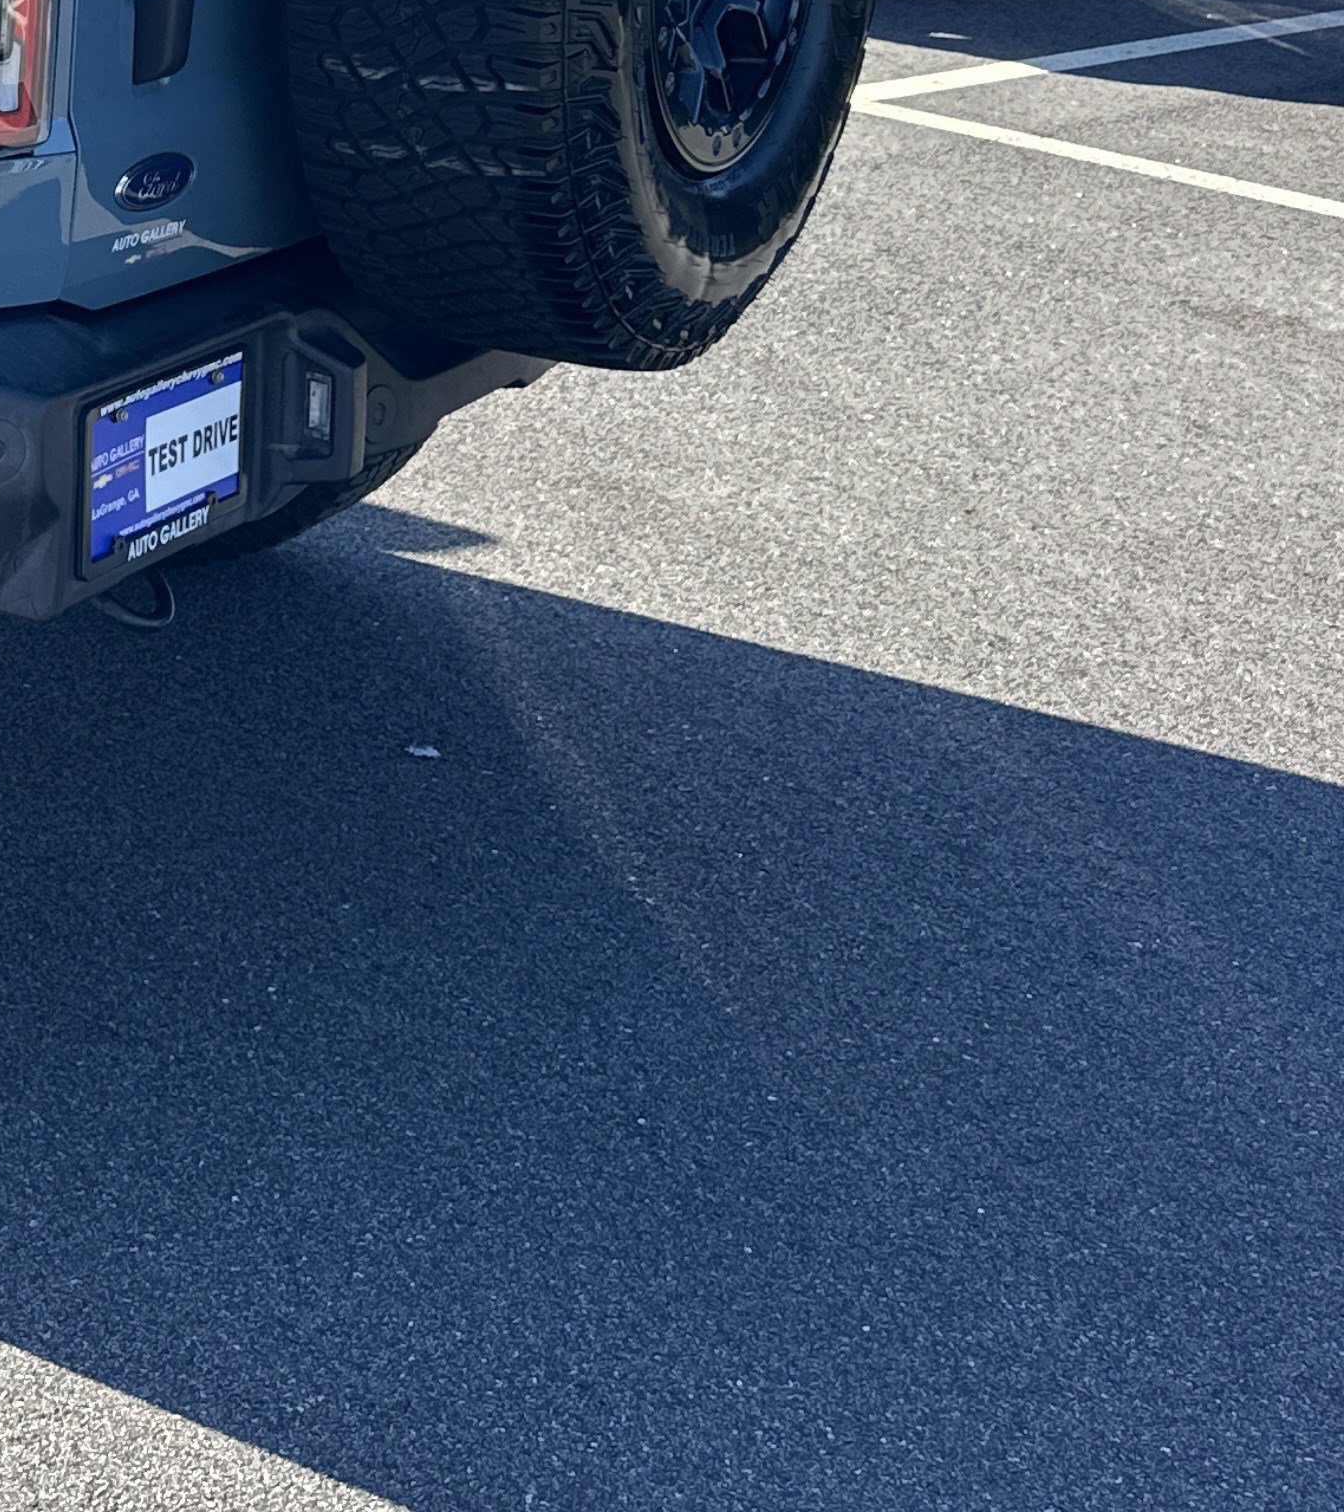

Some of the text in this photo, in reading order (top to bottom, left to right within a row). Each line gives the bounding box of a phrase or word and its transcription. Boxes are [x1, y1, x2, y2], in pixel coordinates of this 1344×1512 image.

[111, 219, 187, 253] AUTO GALLERY
[109, 435, 145, 463] GALLERY
[148, 413, 239, 477] TEST DRIVE
[127, 504, 211, 563] AUTO GALLERY
